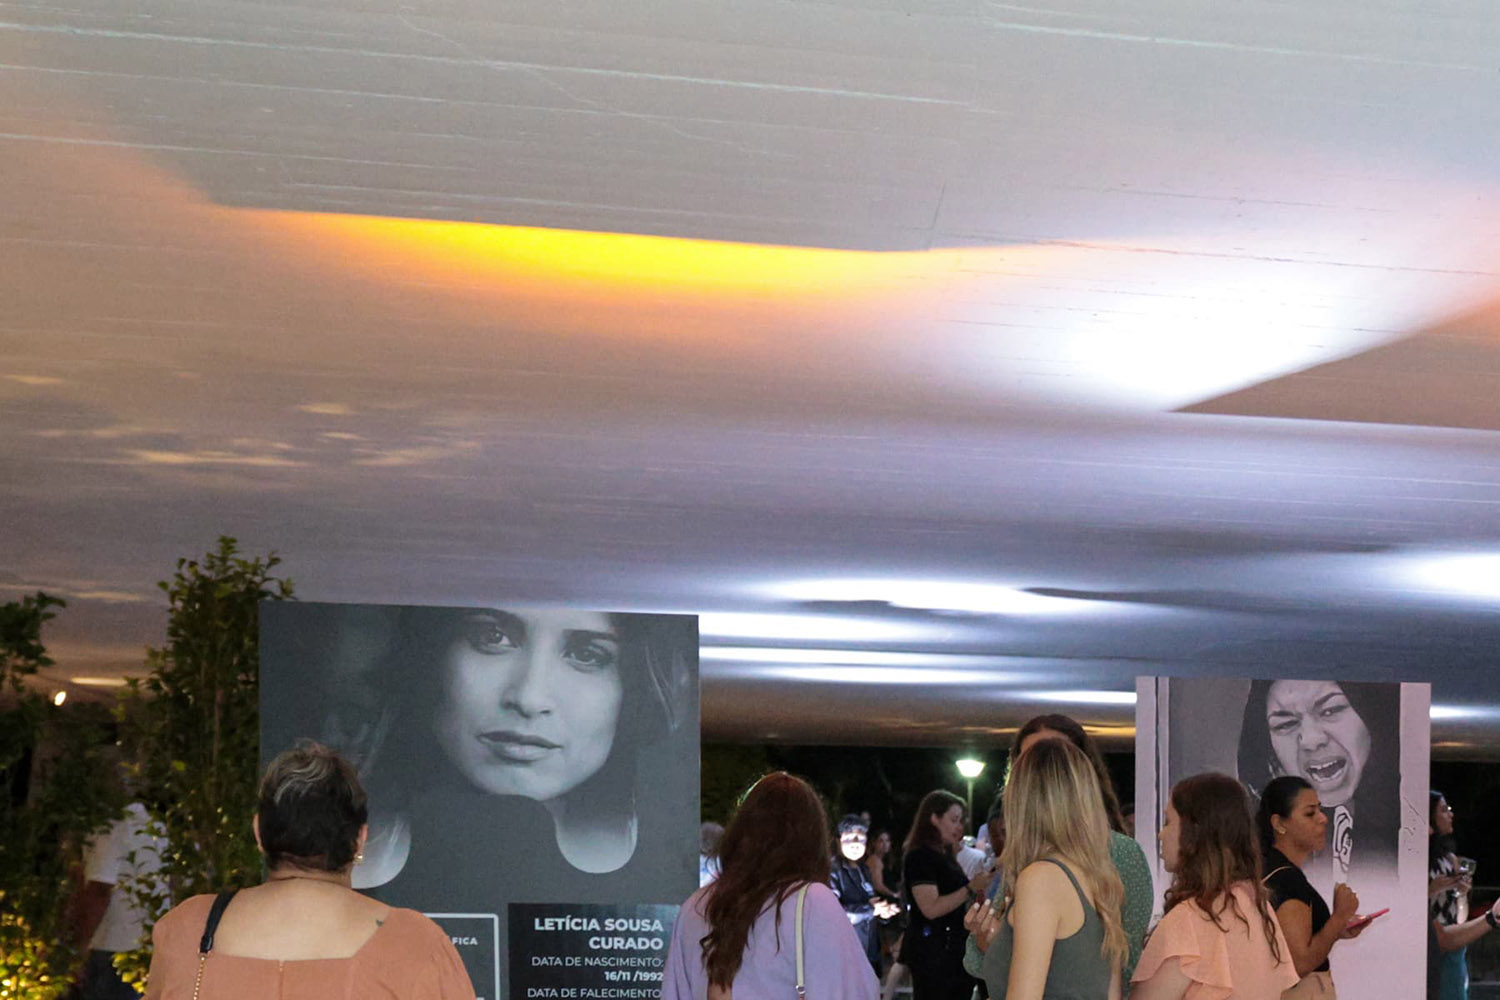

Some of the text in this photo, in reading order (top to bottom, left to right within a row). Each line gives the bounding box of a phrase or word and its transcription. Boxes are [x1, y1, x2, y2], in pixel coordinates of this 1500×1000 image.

[534, 915, 664, 932] LETÍCIA SOUSA
[589, 937, 663, 950] CURADO
[531, 957, 562, 966] DATA
[565, 957, 582, 966] DE
[527, 988, 558, 998] DATA
[561, 988, 577, 998] DE
